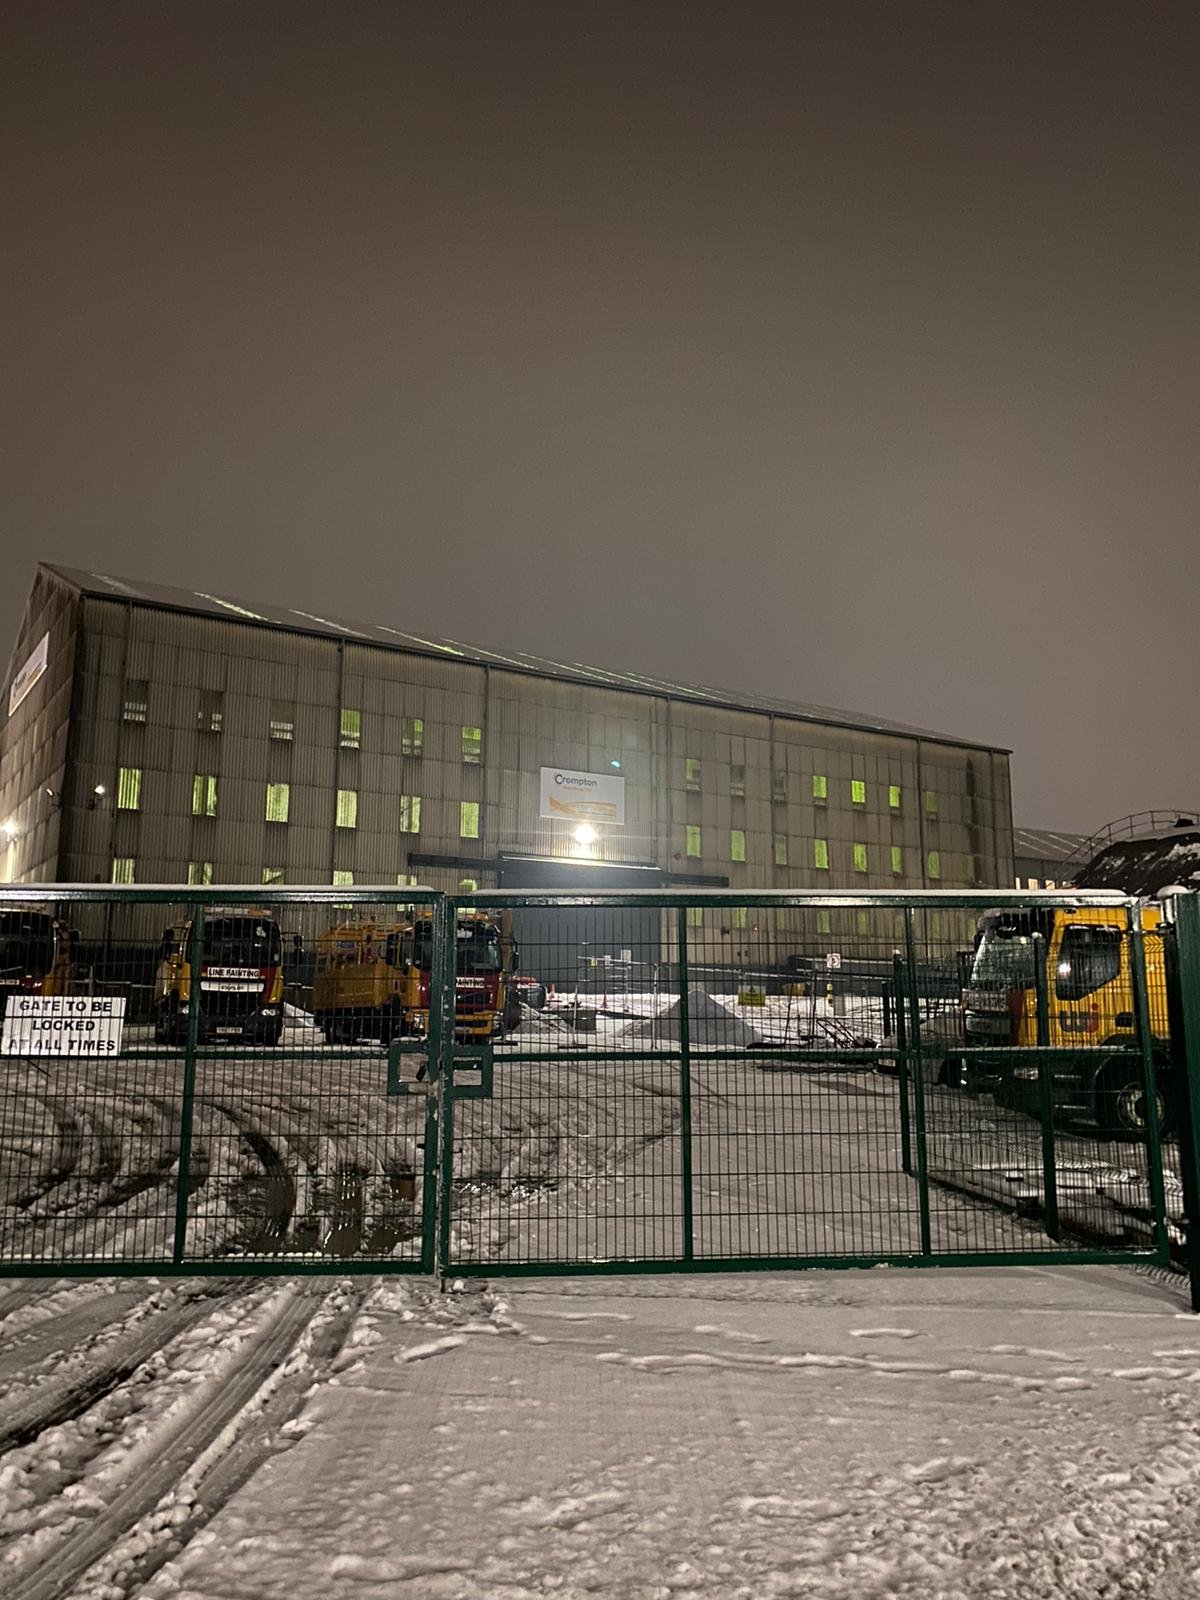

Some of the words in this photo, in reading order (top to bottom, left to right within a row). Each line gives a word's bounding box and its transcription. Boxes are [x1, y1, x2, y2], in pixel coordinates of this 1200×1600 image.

[554, 773, 598, 787] Crompton
[208, 968, 225, 976] LINE
[226, 968, 259, 978] PAINTING
[19, 1000, 61, 1011] GATE
[66, 1001, 87, 1012] TO
[91, 1001, 112, 1012] BE
[32, 1020, 95, 1031] LOCKED
[8, 1039, 29, 1050] AT
[33, 1039, 62, 1050] ALL
[68, 1039, 116, 1051] TIMES
